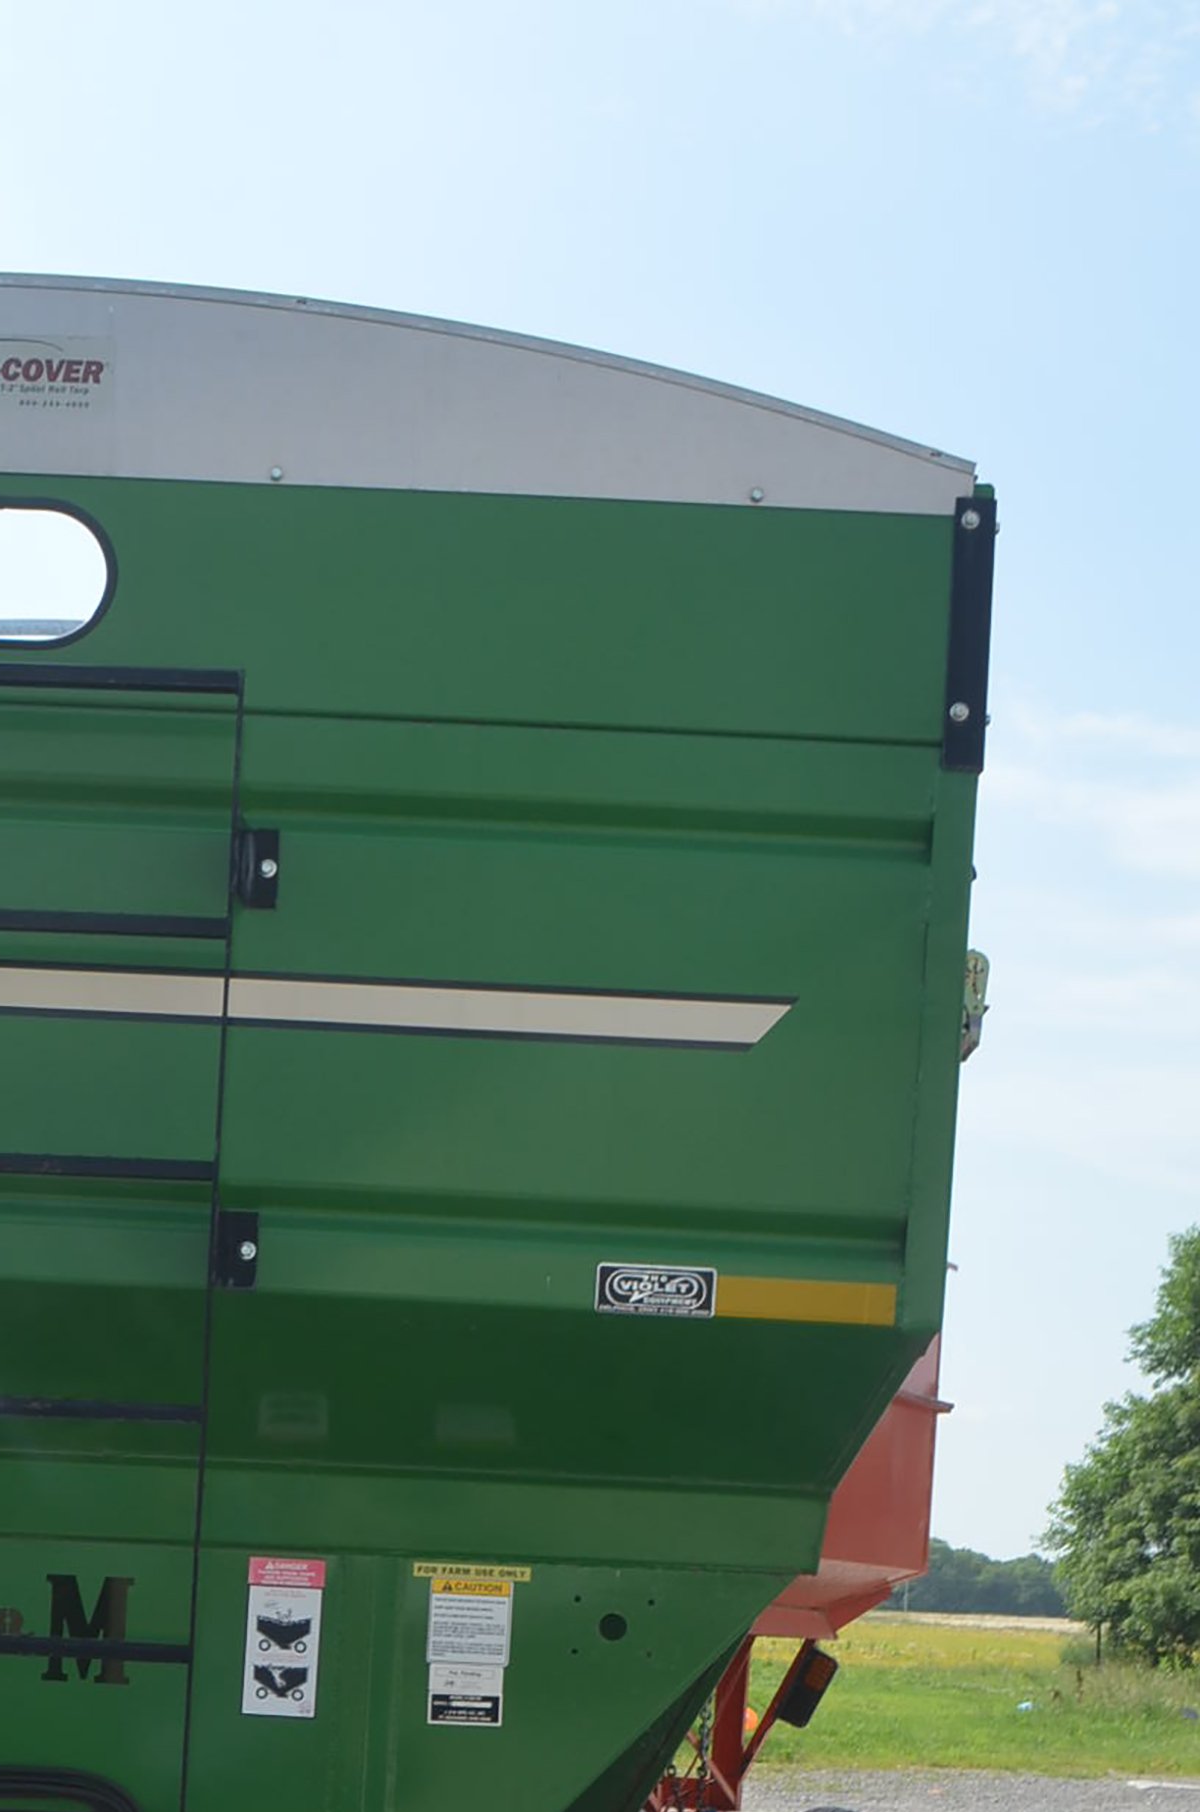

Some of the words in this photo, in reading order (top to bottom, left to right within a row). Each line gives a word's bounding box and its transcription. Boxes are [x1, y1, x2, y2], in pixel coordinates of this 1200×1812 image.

[69, 386, 90, 396] Tarp
[619, 1280, 690, 1294] VIOLET
[416, 1565, 438, 1574] FOR
[441, 1566, 471, 1575] FARM
[474, 1568, 495, 1577] USE
[498, 1569, 528, 1578] ONLY
[453, 1581, 504, 1593] CAUTION
